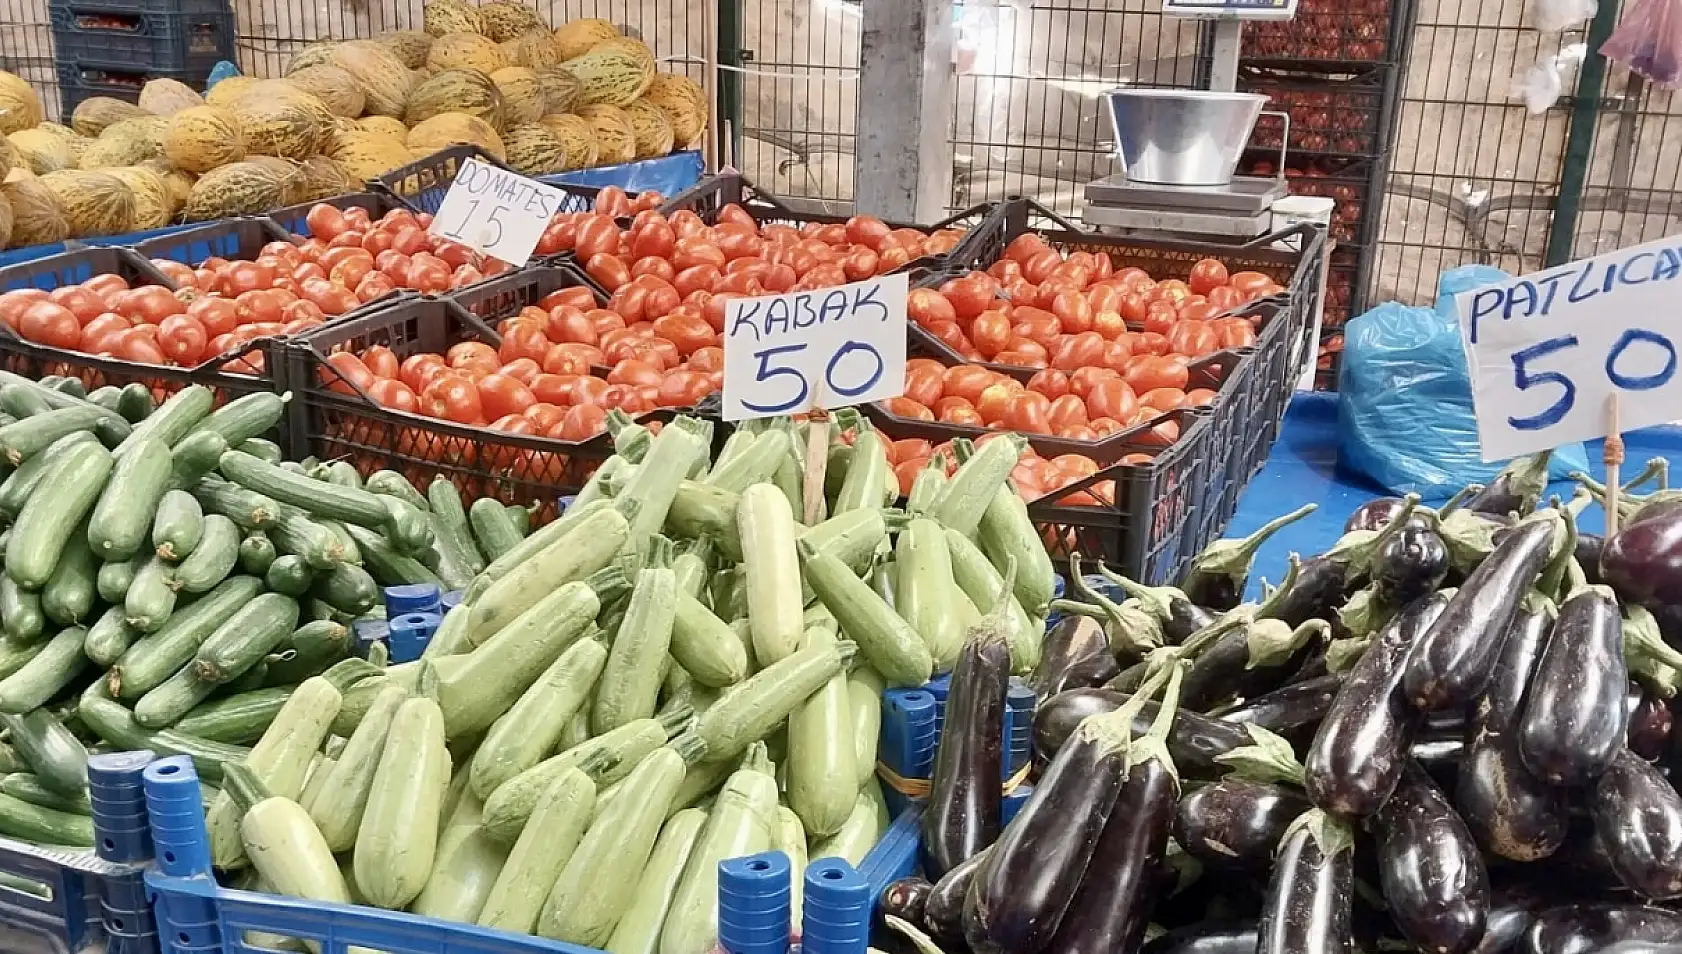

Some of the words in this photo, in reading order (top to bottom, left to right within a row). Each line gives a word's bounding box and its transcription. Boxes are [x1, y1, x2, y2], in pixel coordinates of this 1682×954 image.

[456, 161, 556, 219] DOMATES
[444, 200, 510, 248] 15
[730, 284, 888, 341] KABAK
[1470, 246, 1682, 344] PATLICA
[740, 340, 883, 412] 50
[1507, 328, 1677, 431] 50
